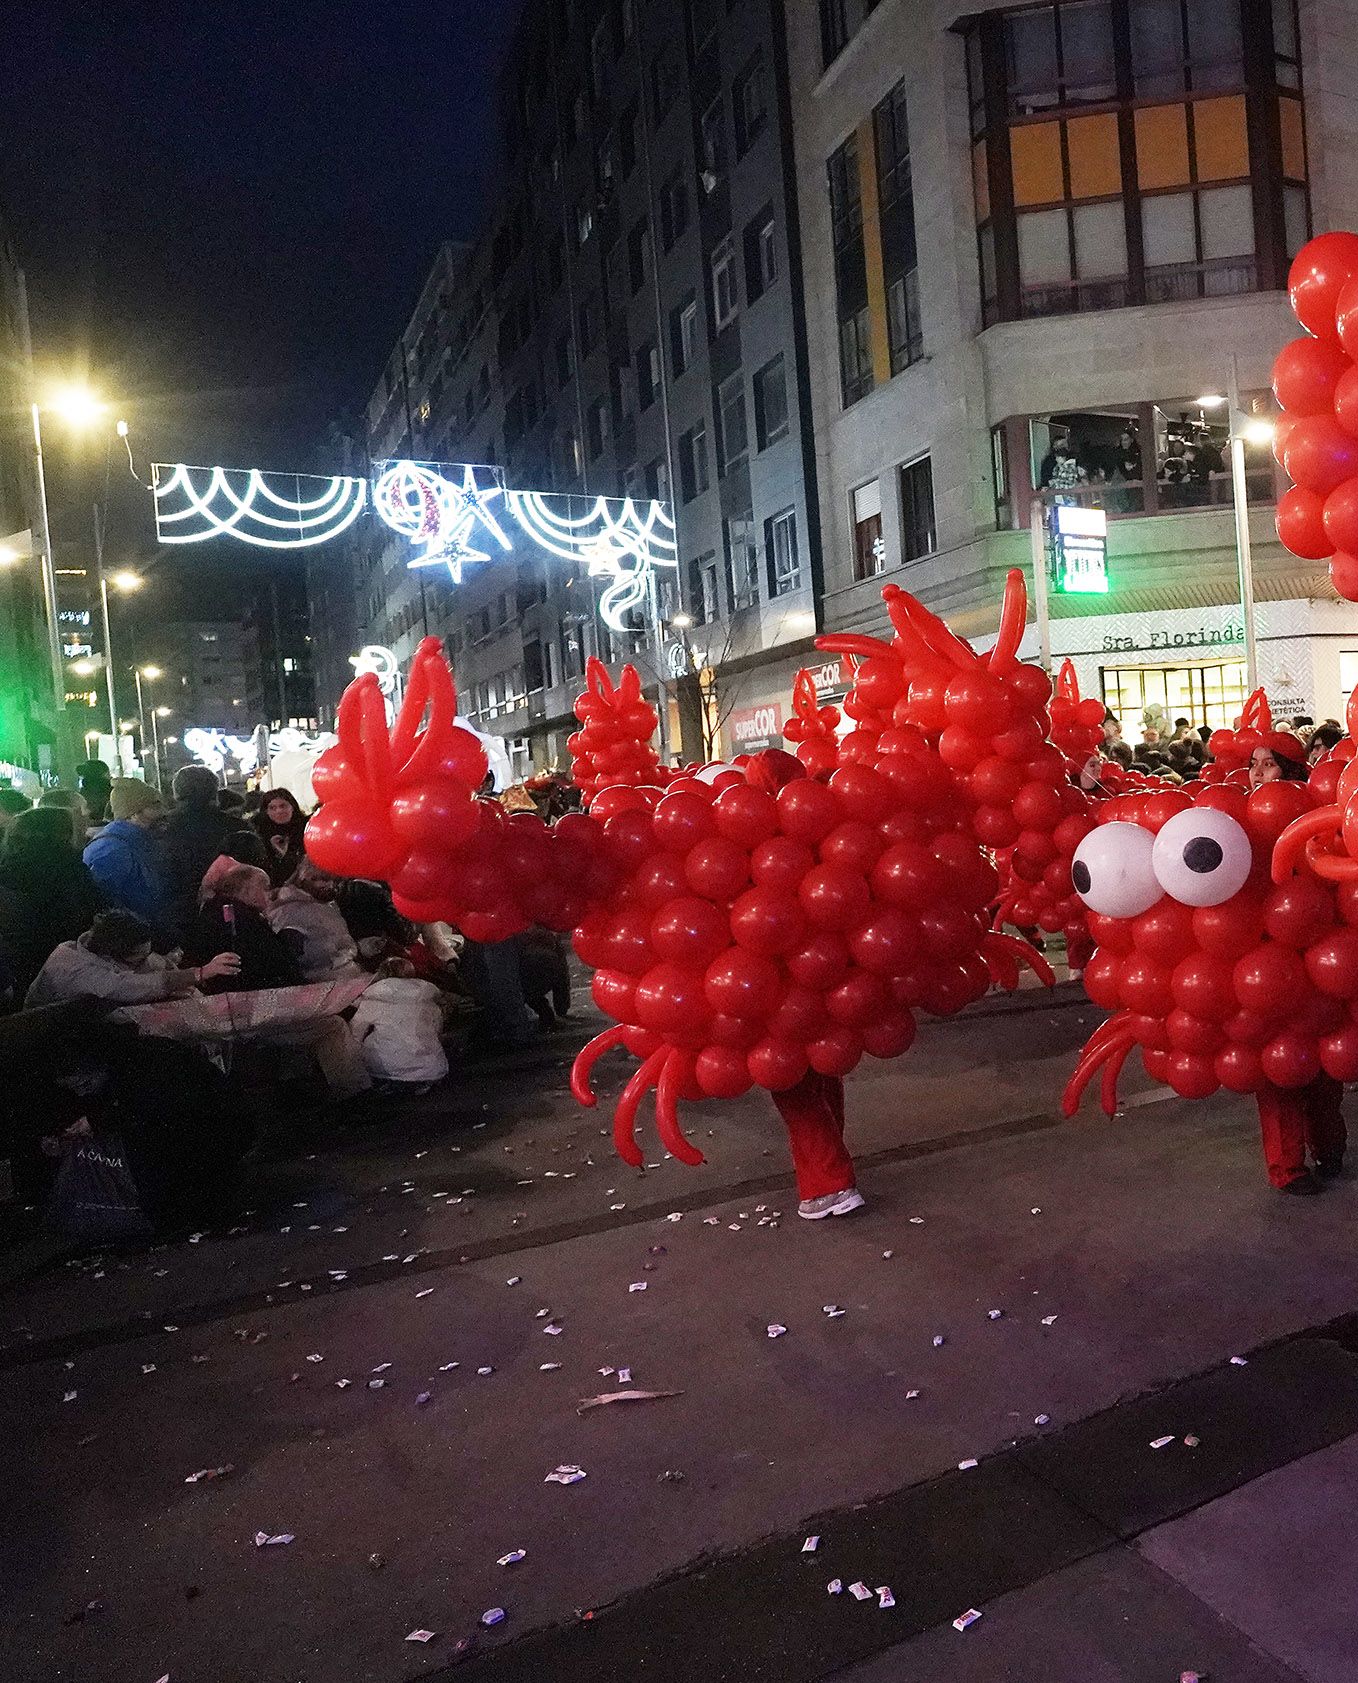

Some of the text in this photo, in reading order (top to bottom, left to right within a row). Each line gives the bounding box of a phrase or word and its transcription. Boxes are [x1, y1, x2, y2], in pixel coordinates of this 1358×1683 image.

[1102, 625, 1245, 650] Sra. Florinda
[1271, 706, 1306, 715] IETÉTICA
[735, 708, 777, 740] SUPERCOR
